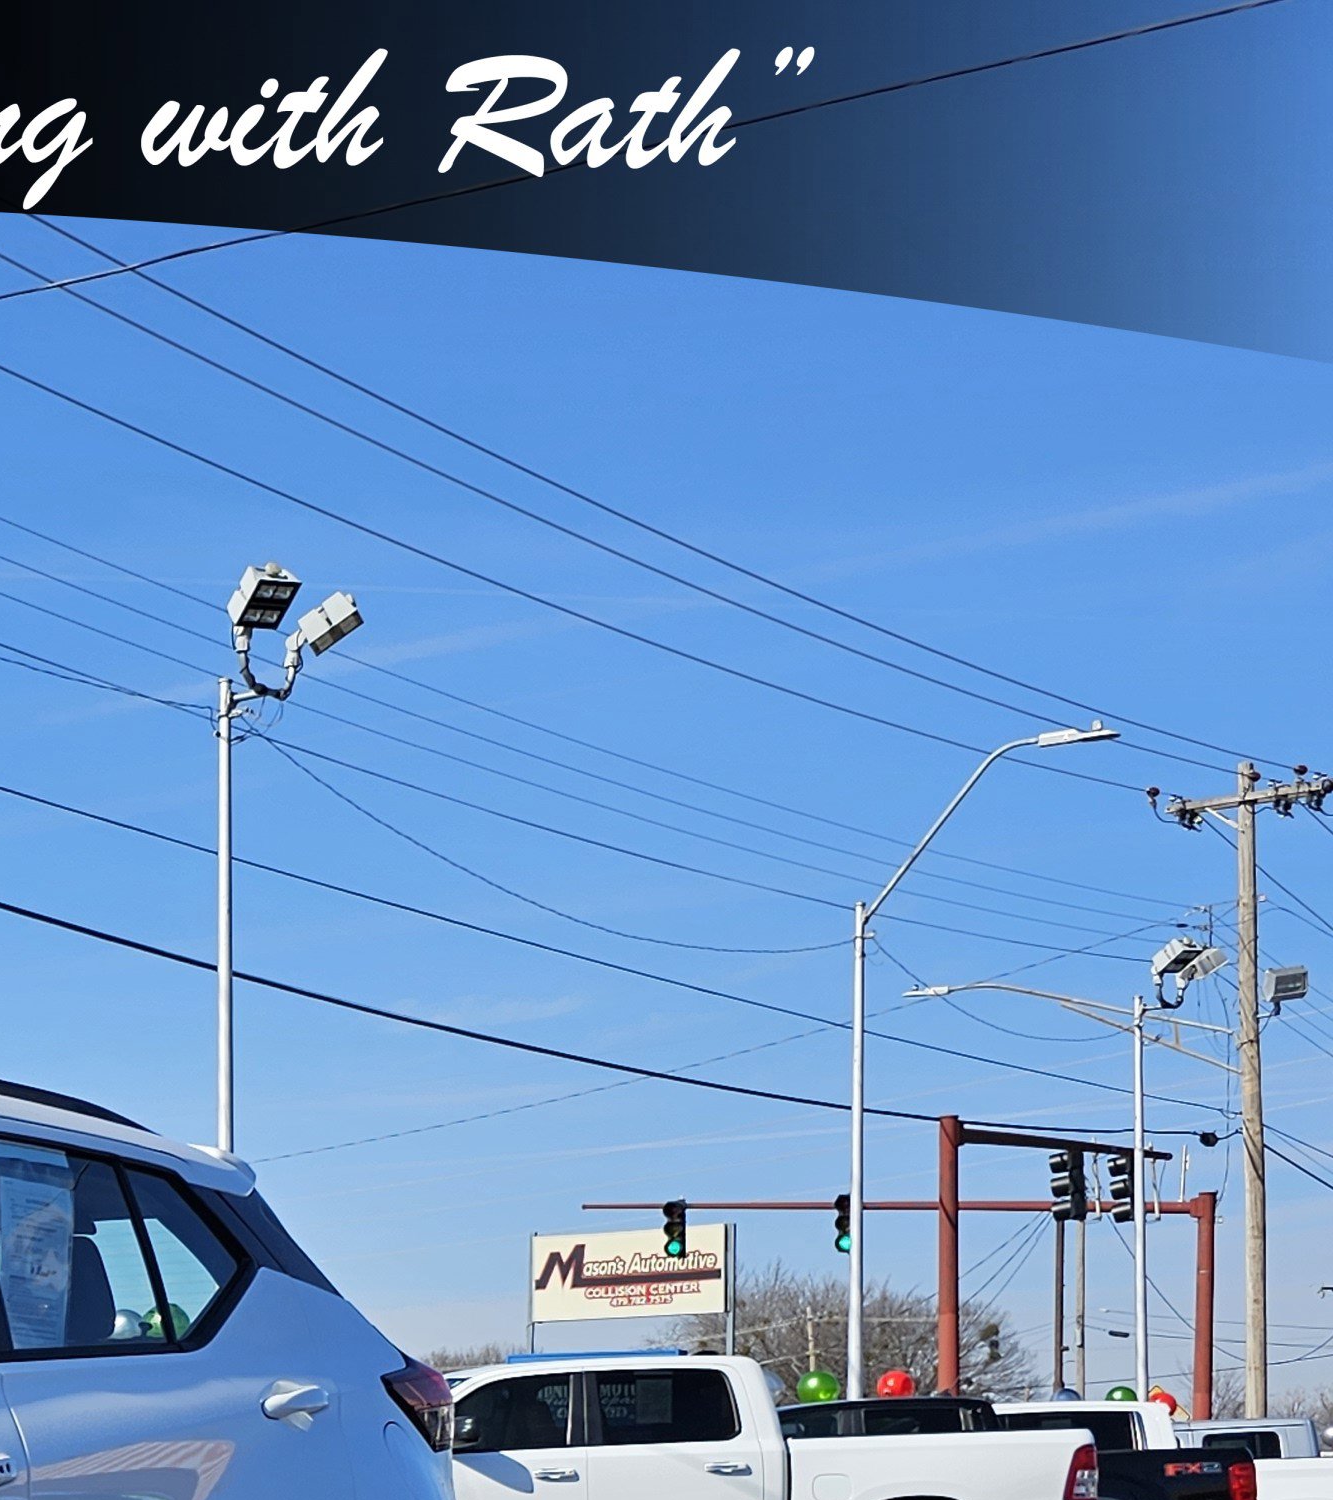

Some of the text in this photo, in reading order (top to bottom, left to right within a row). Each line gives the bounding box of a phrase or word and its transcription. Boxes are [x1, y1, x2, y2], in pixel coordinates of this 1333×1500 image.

[535, 1243, 718, 1290] Mason's Automotive
[585, 1280, 700, 1299] COLLISION CENTER
